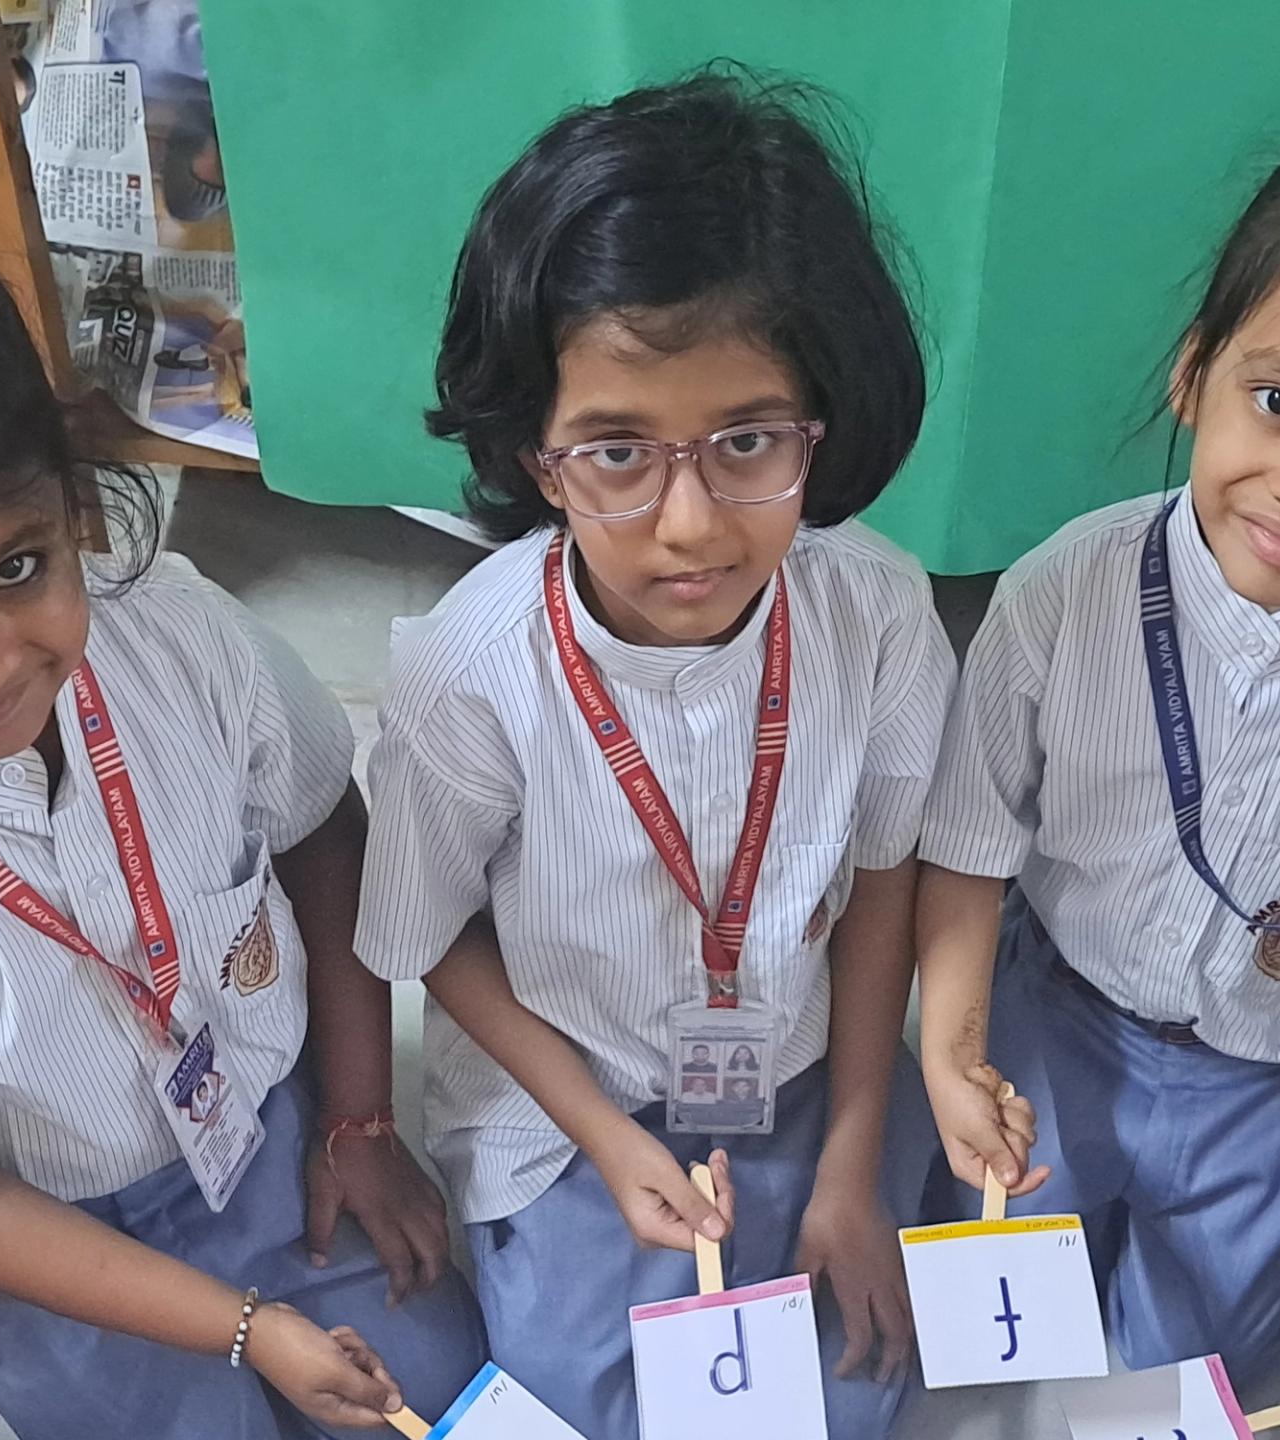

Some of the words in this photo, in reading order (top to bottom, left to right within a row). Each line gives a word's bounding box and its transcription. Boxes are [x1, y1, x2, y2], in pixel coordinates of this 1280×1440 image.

[552, 565, 579, 664] VIDYALAYAM
[573, 665, 607, 716] AMRITA
[770, 631, 785, 690] AMRITA
[1155, 629, 1184, 725] VIDYALAYAM
[1173, 725, 1198, 777] AMRITA
[108, 789, 143, 882] VIDYALAYAM
[631, 777, 680, 855] VIDYALAYAM
[733, 849, 754, 896] AMRITA
[746, 764, 773, 850] VIDYALAYAM
[136, 883, 160, 937] AMRITA
[219, 922, 252, 991] AMRITA
